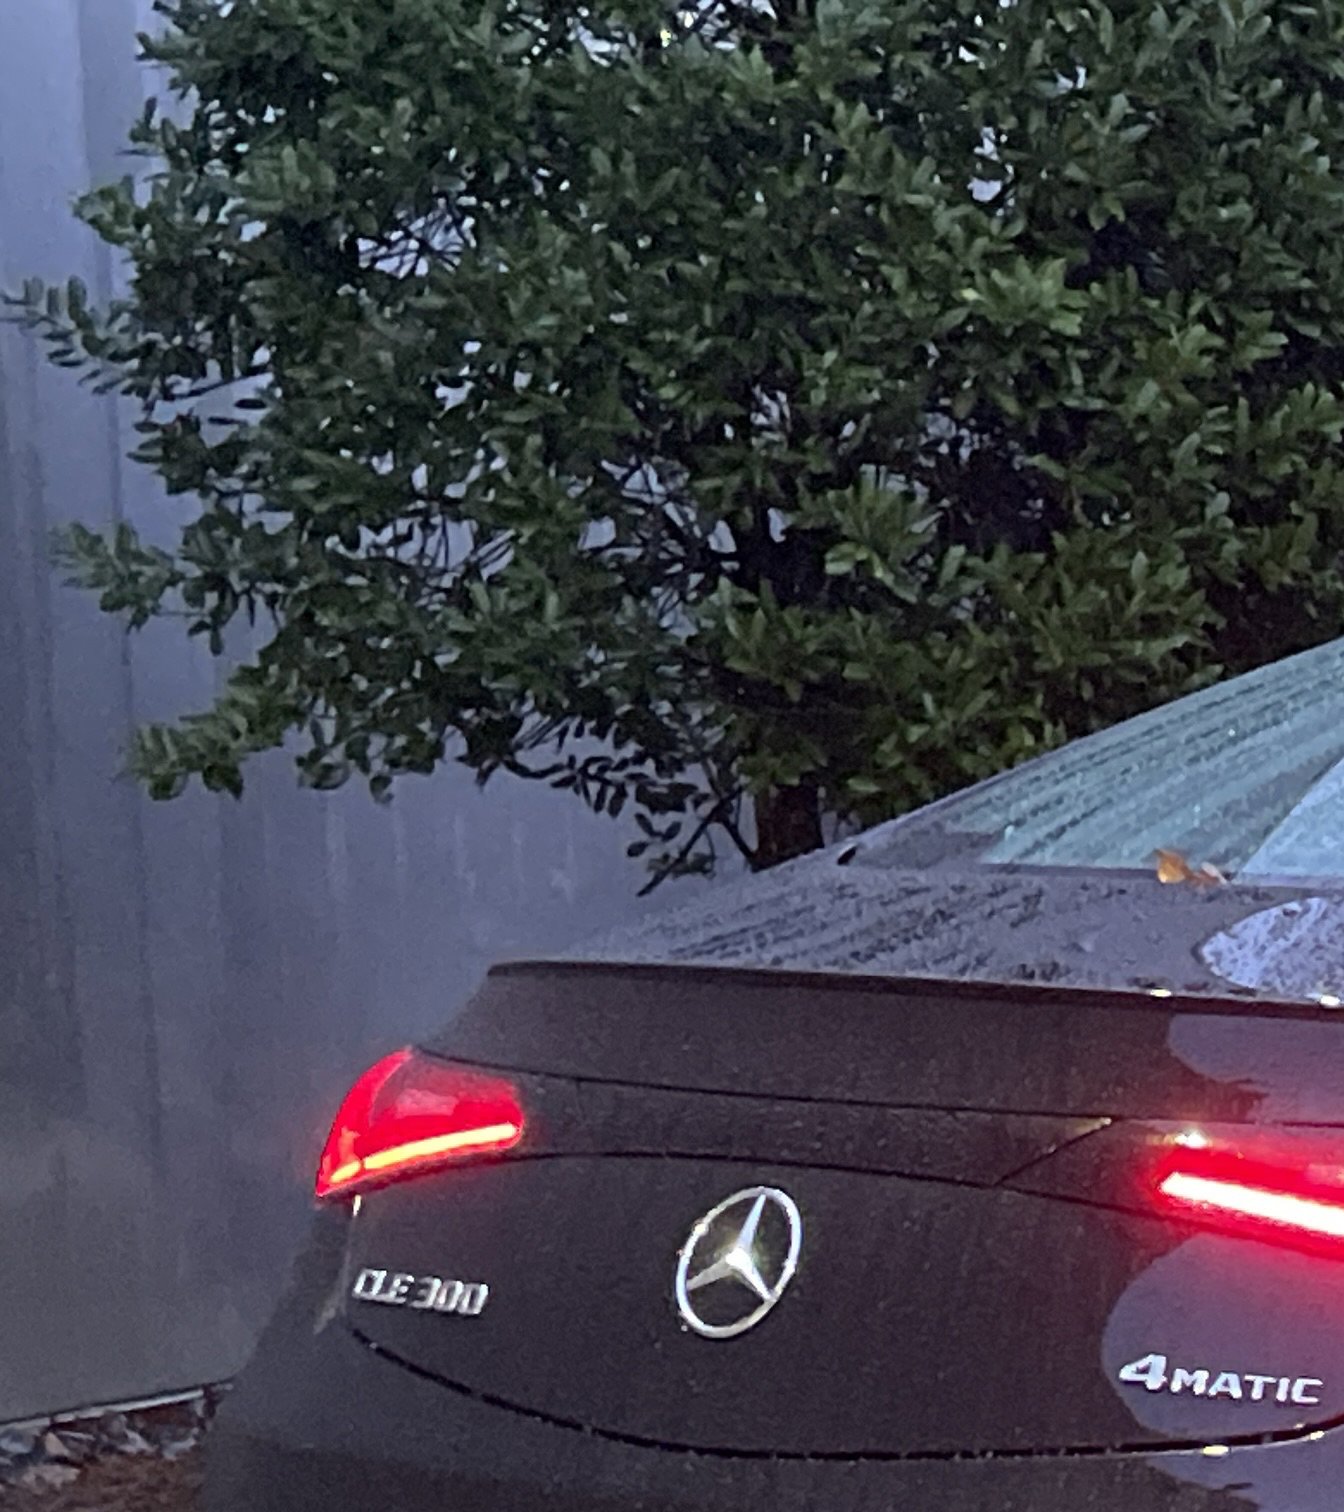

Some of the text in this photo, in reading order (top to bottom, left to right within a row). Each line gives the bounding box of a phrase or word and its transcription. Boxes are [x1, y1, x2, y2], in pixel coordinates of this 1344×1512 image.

[351, 1268, 489, 1315] CLE 300
[1118, 1354, 1324, 1404] 4MATIC
